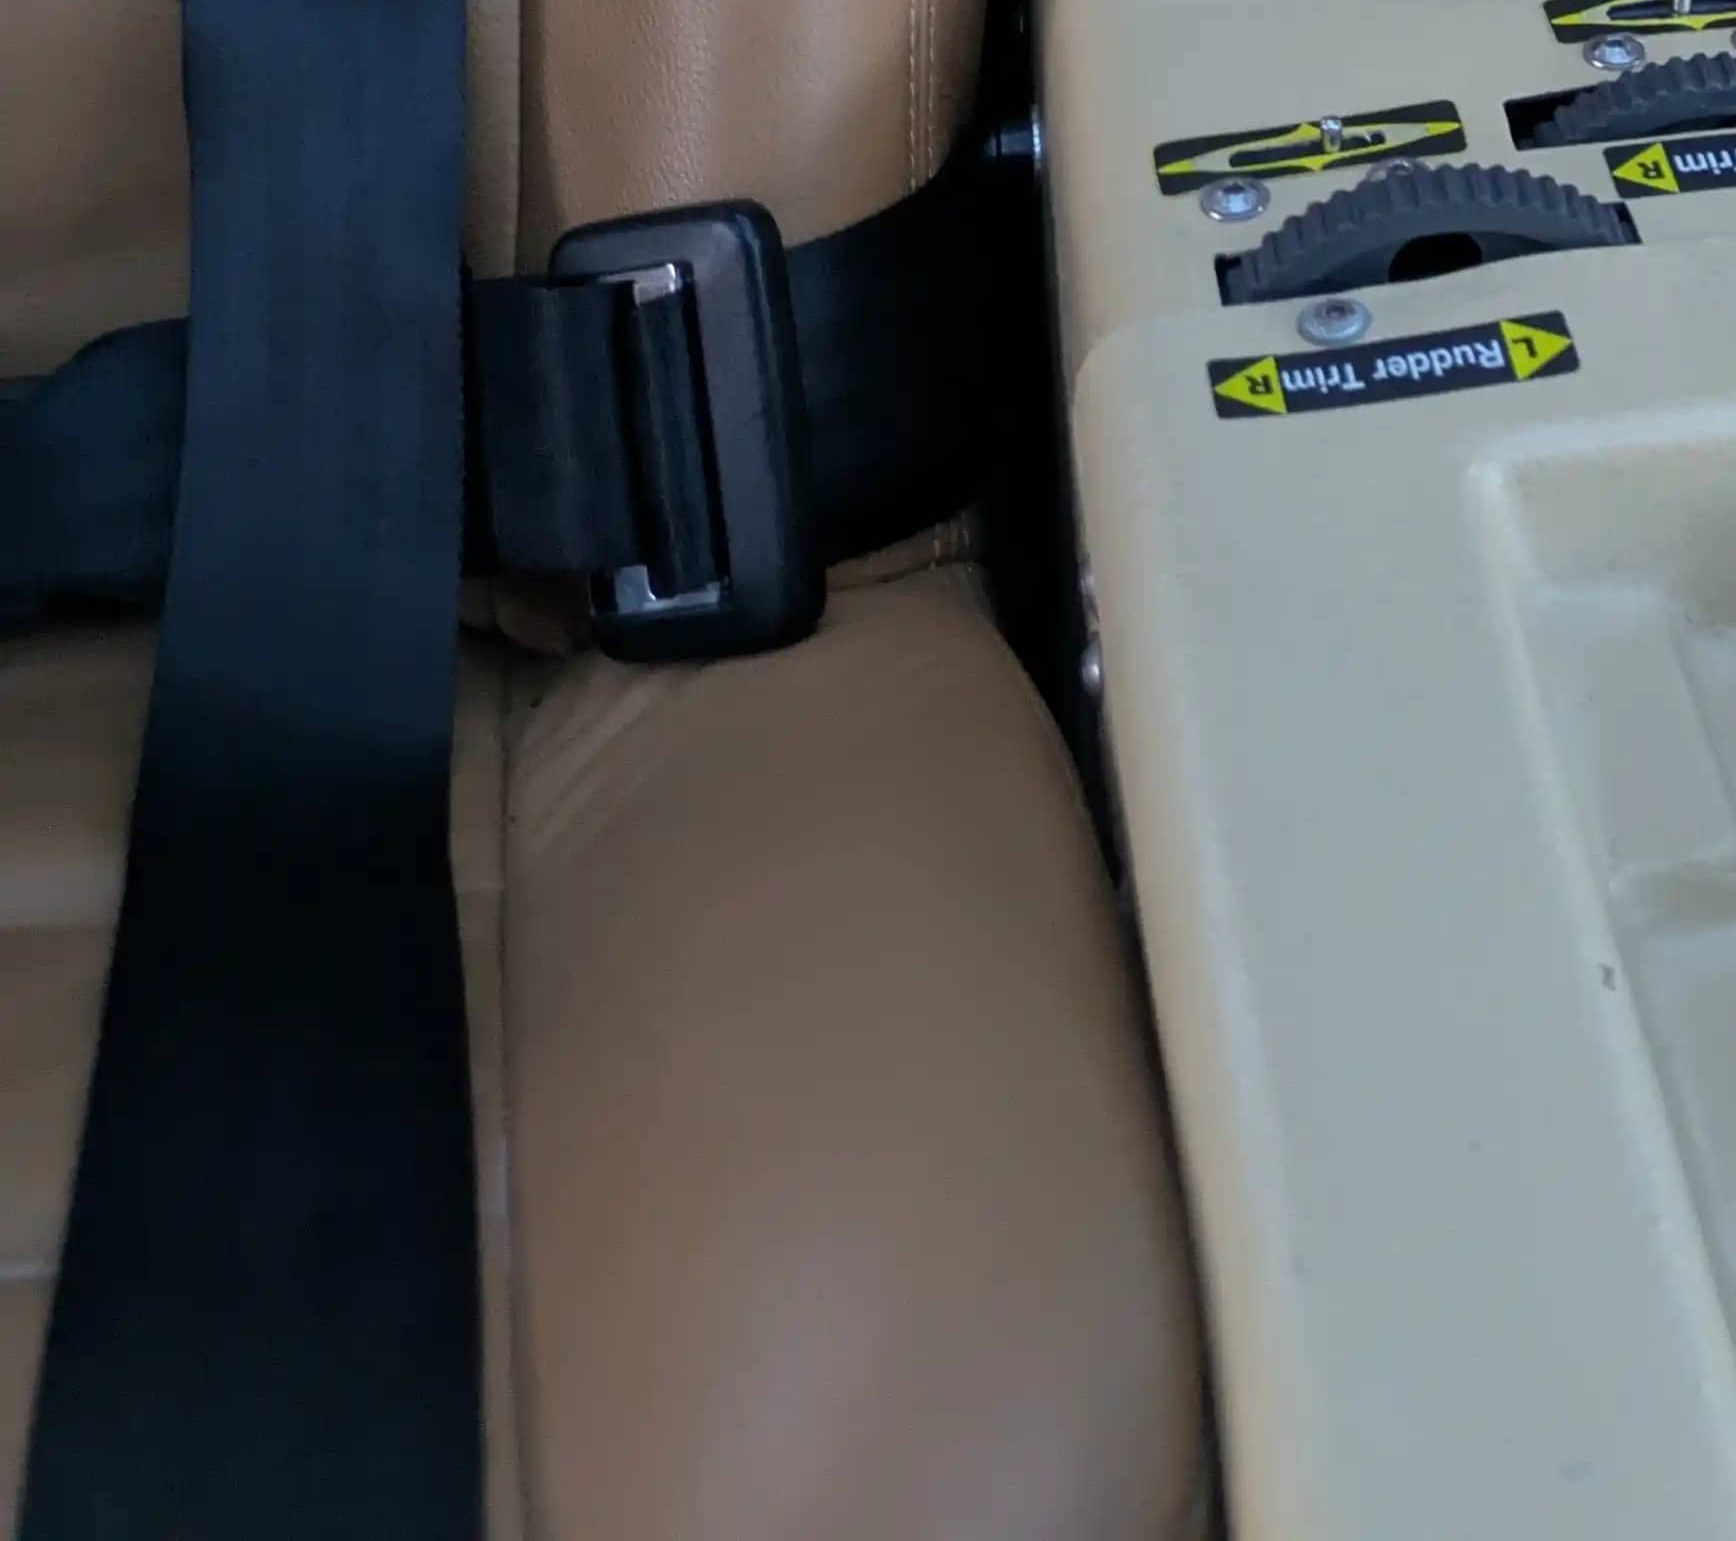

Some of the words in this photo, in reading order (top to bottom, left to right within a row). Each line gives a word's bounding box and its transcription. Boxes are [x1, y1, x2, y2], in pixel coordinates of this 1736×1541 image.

[1637, 162, 1664, 179] R
[1512, 336, 1539, 359] L
[1371, 338, 1506, 382] Rudder
[1245, 374, 1273, 396] R
[1282, 365, 1366, 395] Trim
